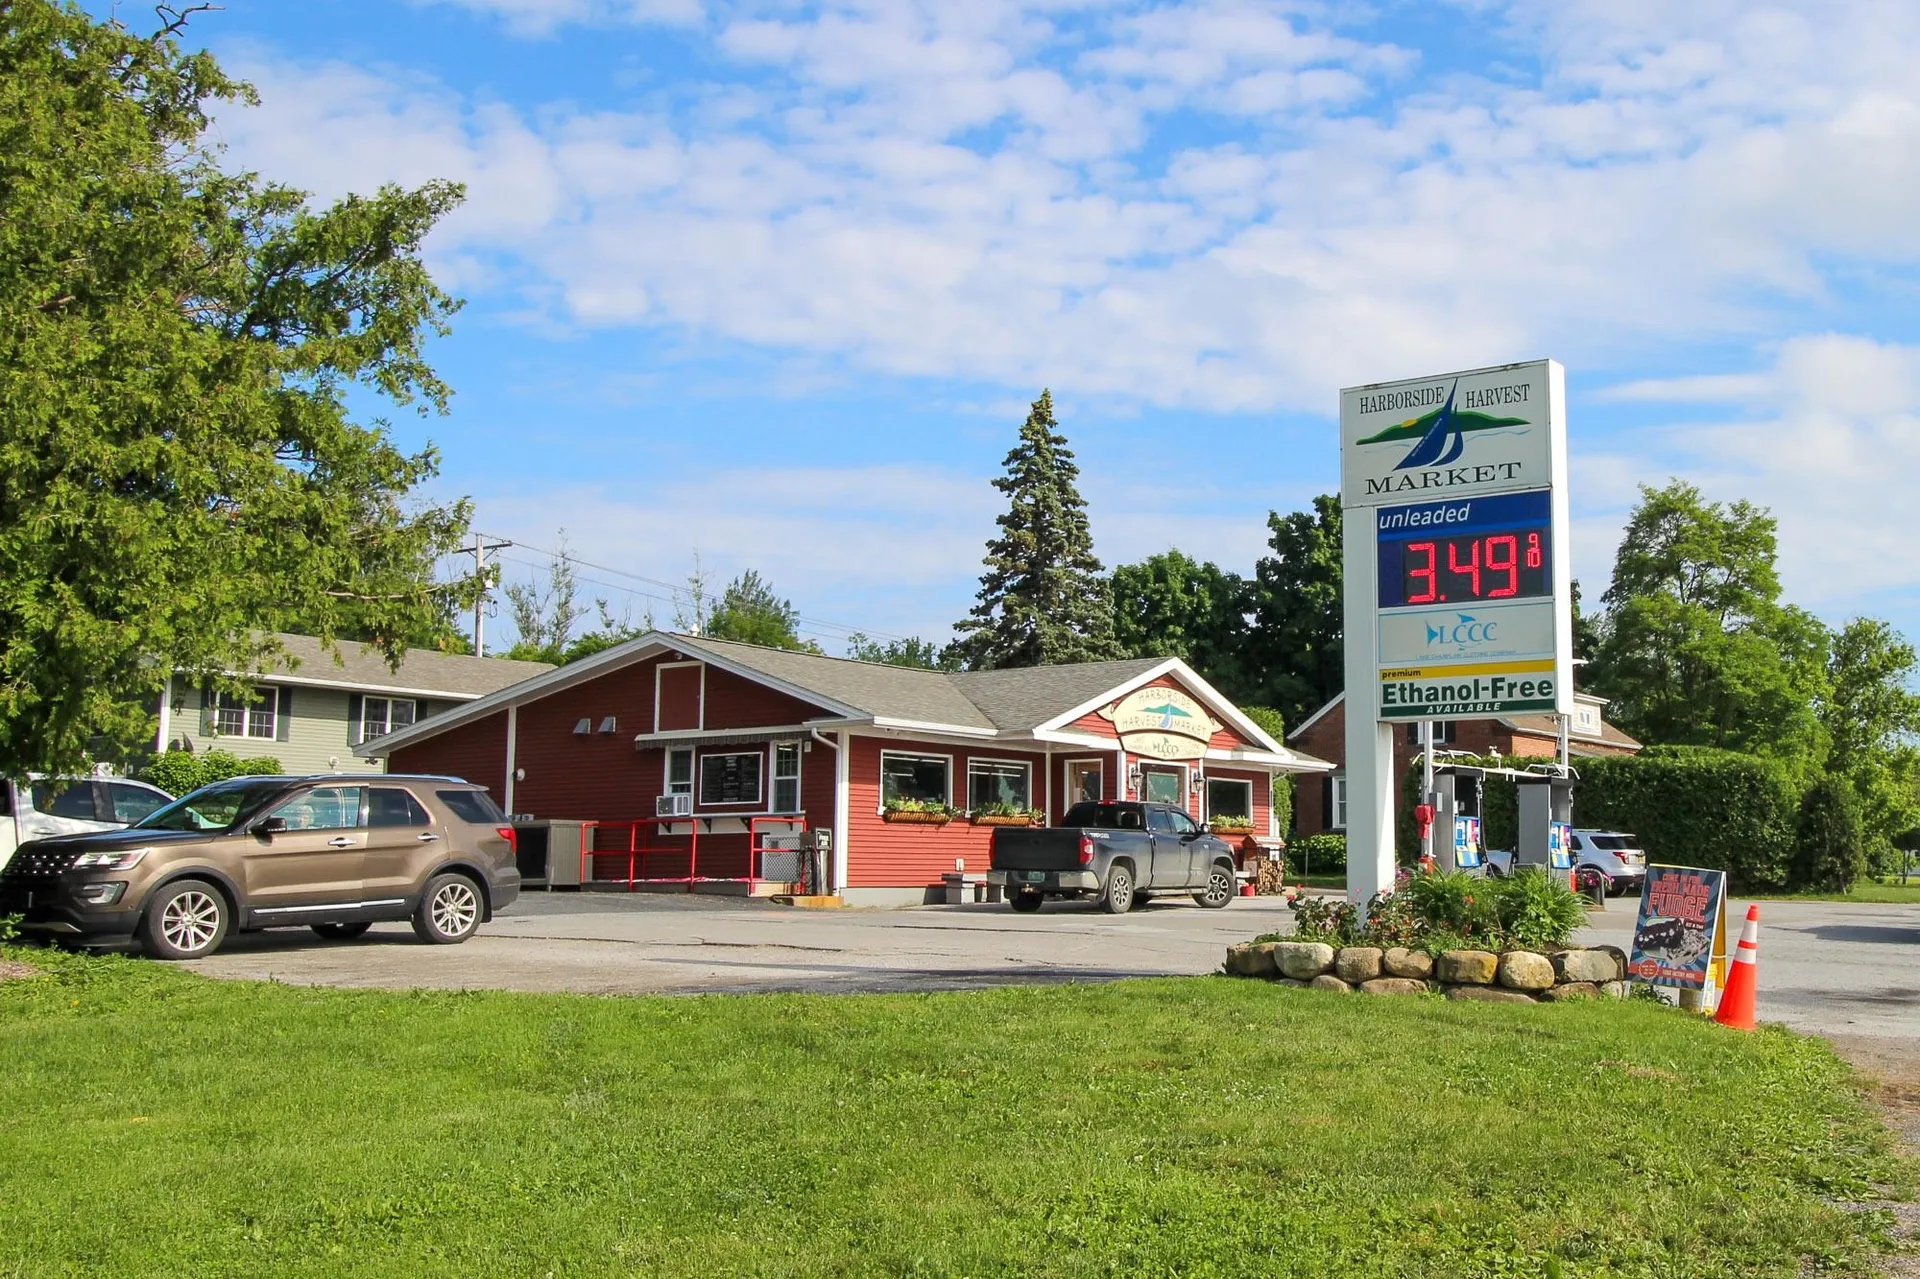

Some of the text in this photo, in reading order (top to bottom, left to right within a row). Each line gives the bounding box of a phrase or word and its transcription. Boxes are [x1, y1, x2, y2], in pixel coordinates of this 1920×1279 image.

[1359, 383, 1530, 414] HARBORSIDE HARVEST
[1365, 461, 1522, 495] MARKET
[1379, 503, 1471, 530] unleaded
[1407, 535, 1518, 603] 3.49
[1439, 621, 1498, 645] LCCC
[1381, 668, 1421, 680] premium
[1138, 688, 1192, 709] HARBORSIDE
[1382, 677, 1554, 705] Ethanol-Free
[1426, 702, 1502, 714] AVAILABLE
[1122, 715, 1207, 736] HARVEST MARKET
[1651, 880, 1711, 897] FRESH MADE
[1646, 892, 1708, 919] FUDGE
